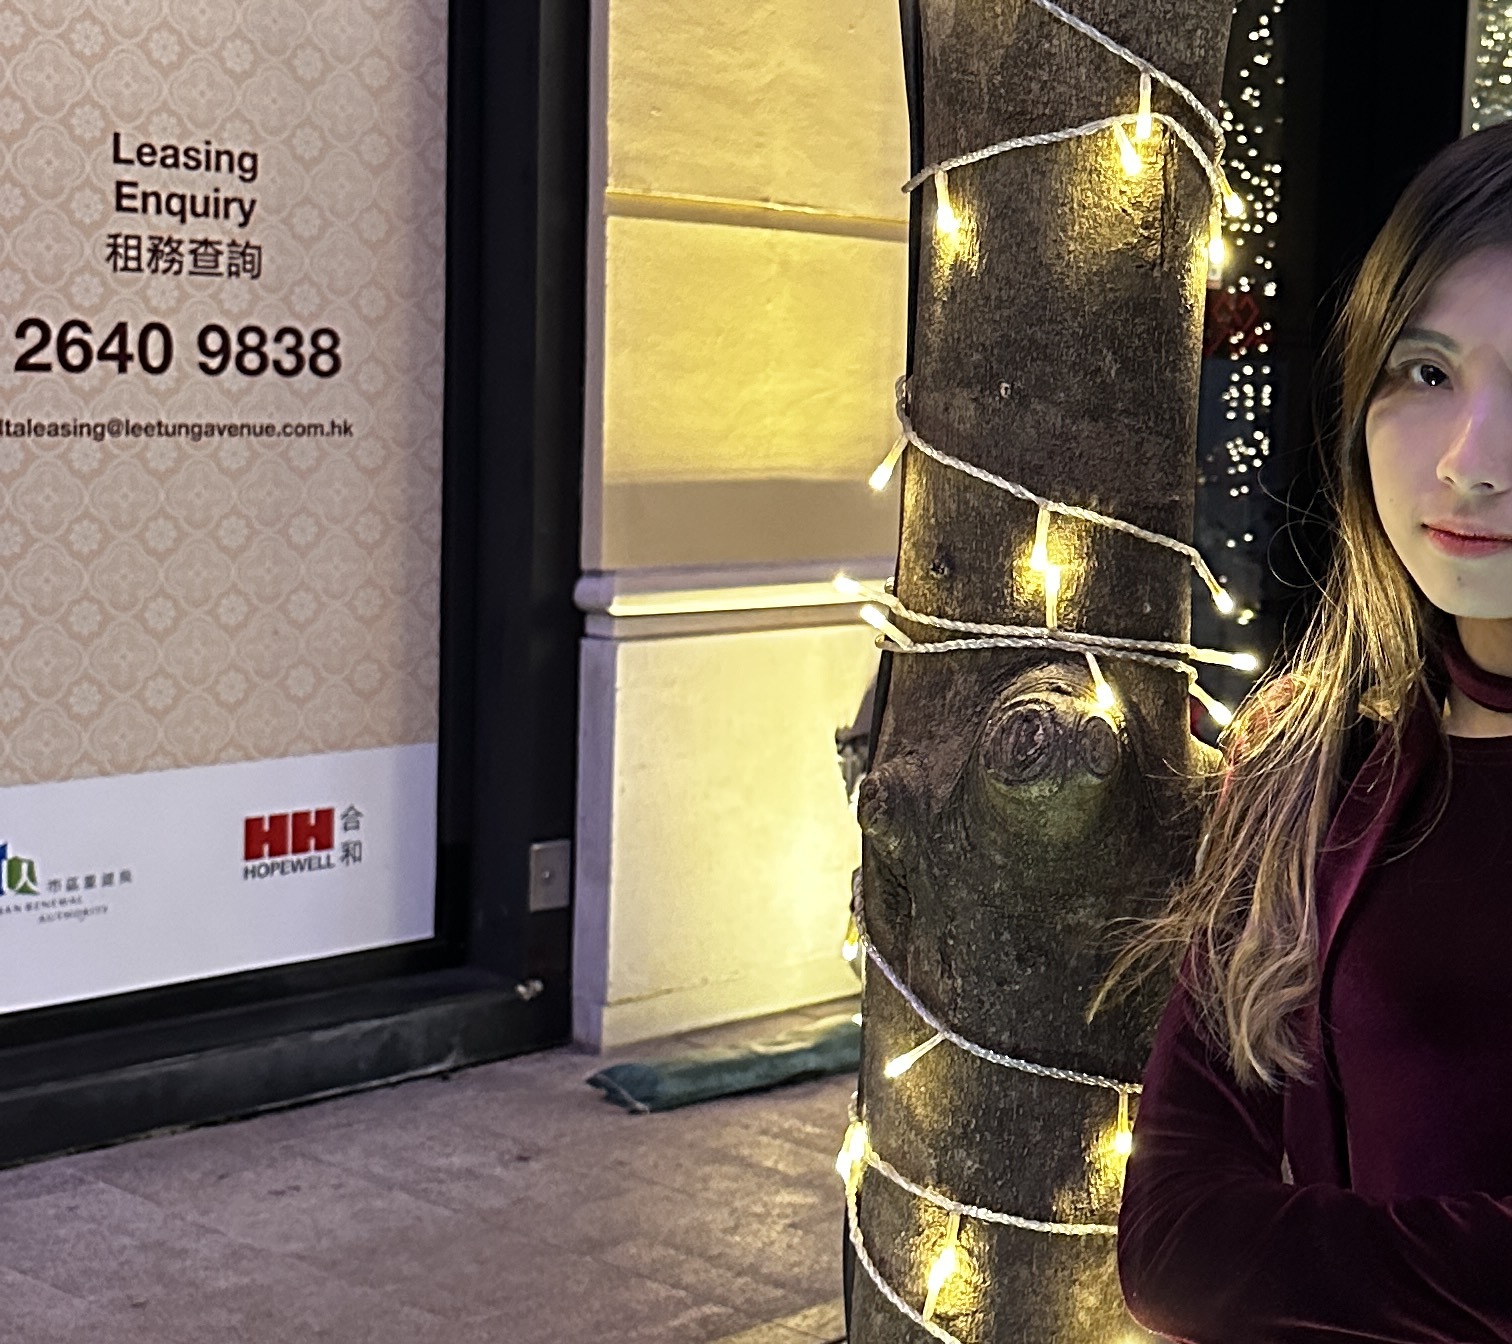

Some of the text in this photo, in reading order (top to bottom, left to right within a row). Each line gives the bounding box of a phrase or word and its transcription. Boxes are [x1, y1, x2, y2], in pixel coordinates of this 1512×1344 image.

[112, 132, 259, 183] Leasing
[114, 180, 257, 228] Enquiry
[105, 232, 263, 281] 租務查詢
[14, 317, 342, 378] 2640 9838
[340, 803, 364, 867] 合和
[243, 854, 336, 881] HOPEWELL
